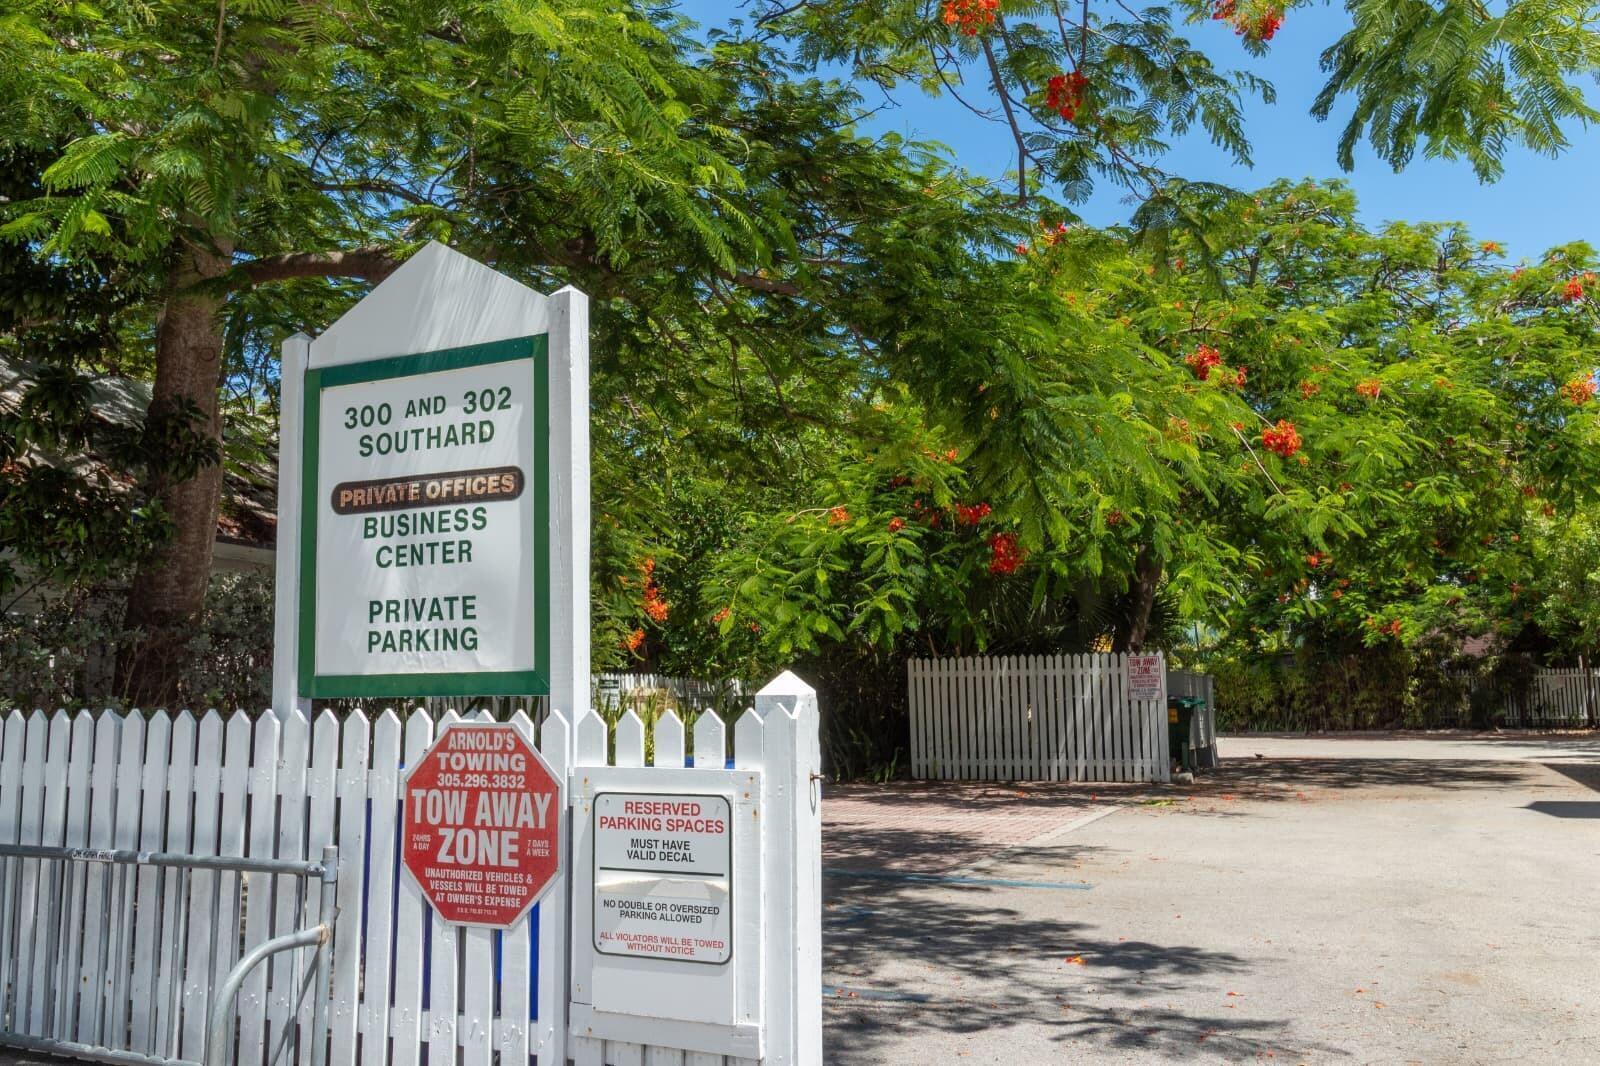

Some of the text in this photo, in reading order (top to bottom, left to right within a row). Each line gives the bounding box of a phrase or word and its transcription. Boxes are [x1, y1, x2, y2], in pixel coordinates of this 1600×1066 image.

[344, 387, 511, 429] 300 AND 302
[359, 420, 494, 457] SOUTHARD
[340, 474, 514, 507] PRIVATE OFFICES
[364, 507, 487, 539] BUSINESS
[376, 540, 472, 568] CENTER
[369, 596, 476, 623] PRIVATE
[368, 627, 478, 653] PARKING
[448, 732, 514, 750] ARNOLD'S
[437, 753, 525, 771] TOWING
[438, 774, 525, 788] 305.296.3832
[412, 789, 551, 829] TOW AWAY
[625, 801, 700, 816] RESERVED
[600, 816, 724, 833] PARKING SPACES
[437, 828, 519, 867] ZONE
[533, 840, 548, 848] DAYS
[631, 839, 690, 850] MUST HAVE
[627, 850, 695, 862] VALID DECAL
[425, 868, 483, 881] UNAUTHORIZED
[485, 872, 524, 882] VEHICLES
[430, 880, 527, 896] VESSELS WILL BE TOWED
[436, 893, 521, 908] AT OWNER'S EXPENSE
[604, 900, 719, 915] NO DOUBLE OR OVERSIZED
[620, 910, 702, 923] PARKING ALLOWED
[616, 933, 658, 943] VIOLATORS
[661, 936, 678, 945] WILL
[681, 938, 692, 946] BE
[694, 939, 724, 949] TOWED
[627, 942, 694, 955] WITHOUT NOTICE
